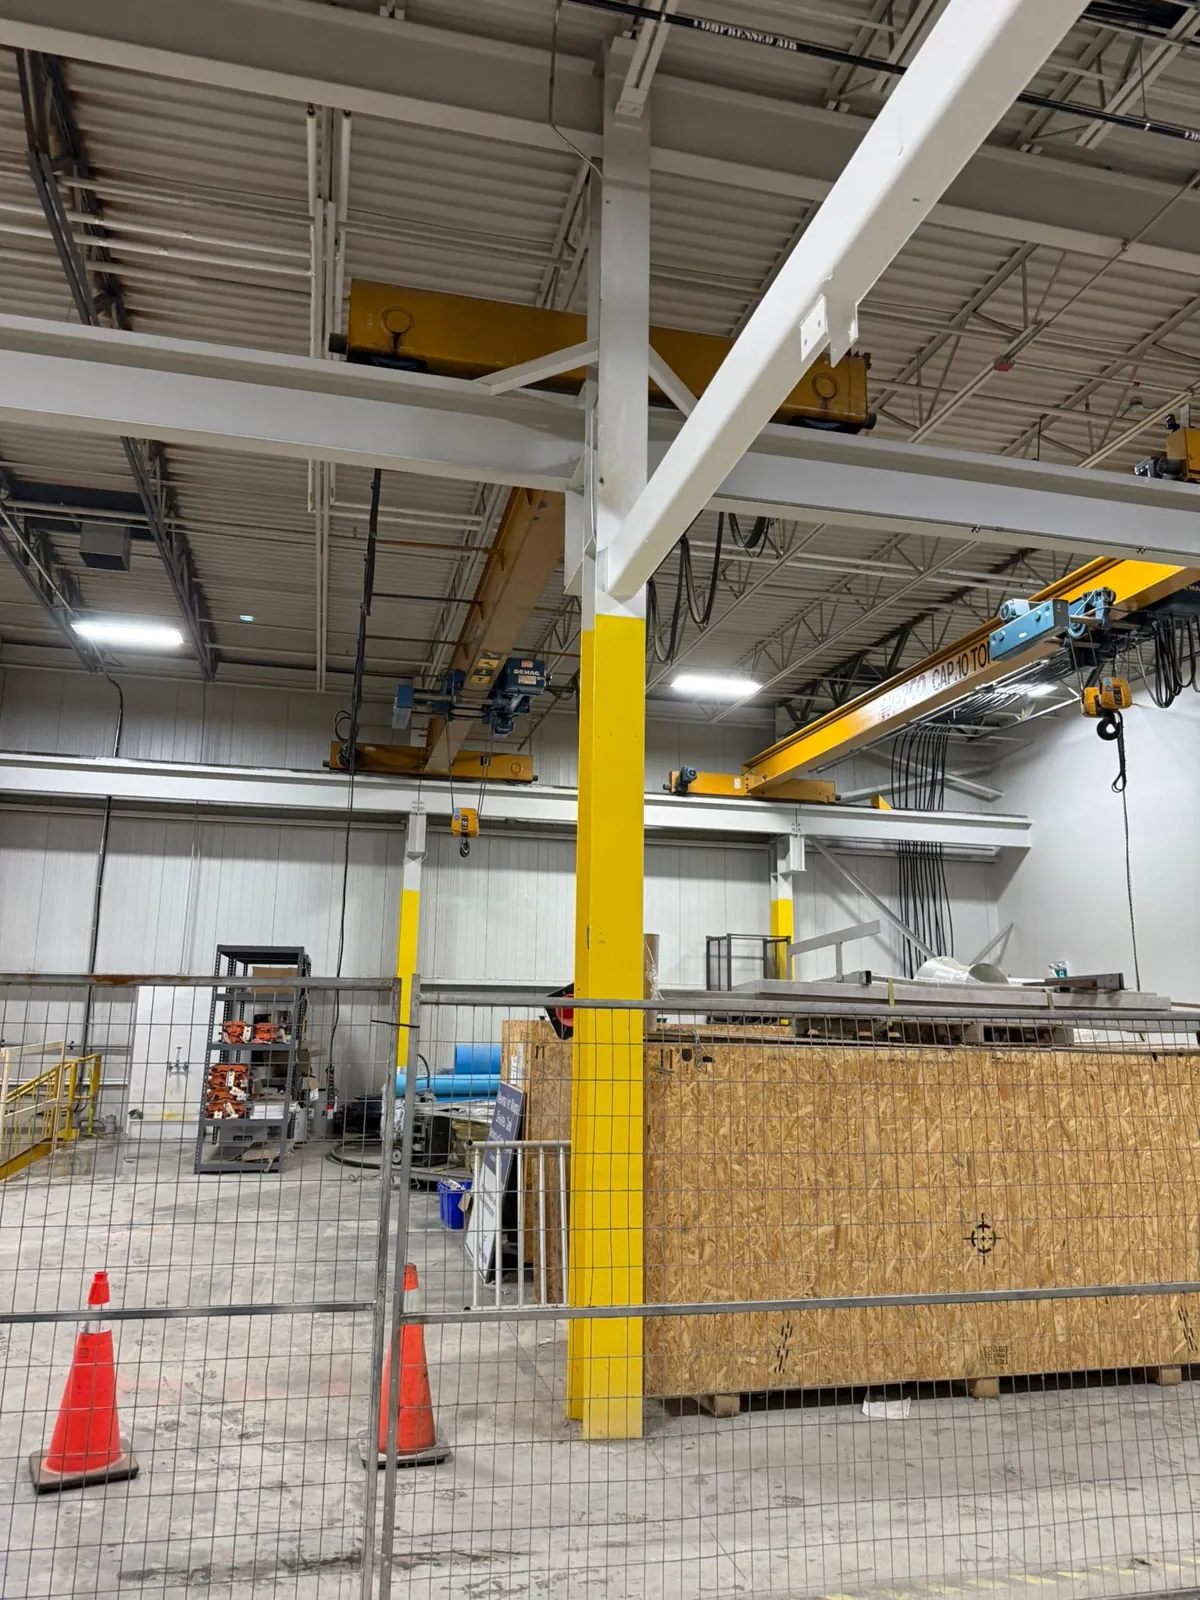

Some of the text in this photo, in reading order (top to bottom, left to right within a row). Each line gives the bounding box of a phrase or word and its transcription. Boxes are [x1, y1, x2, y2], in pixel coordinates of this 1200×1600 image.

[693, 19, 798, 51] COMPRESSED AIR
[513, 668, 540, 677] DEMAG
